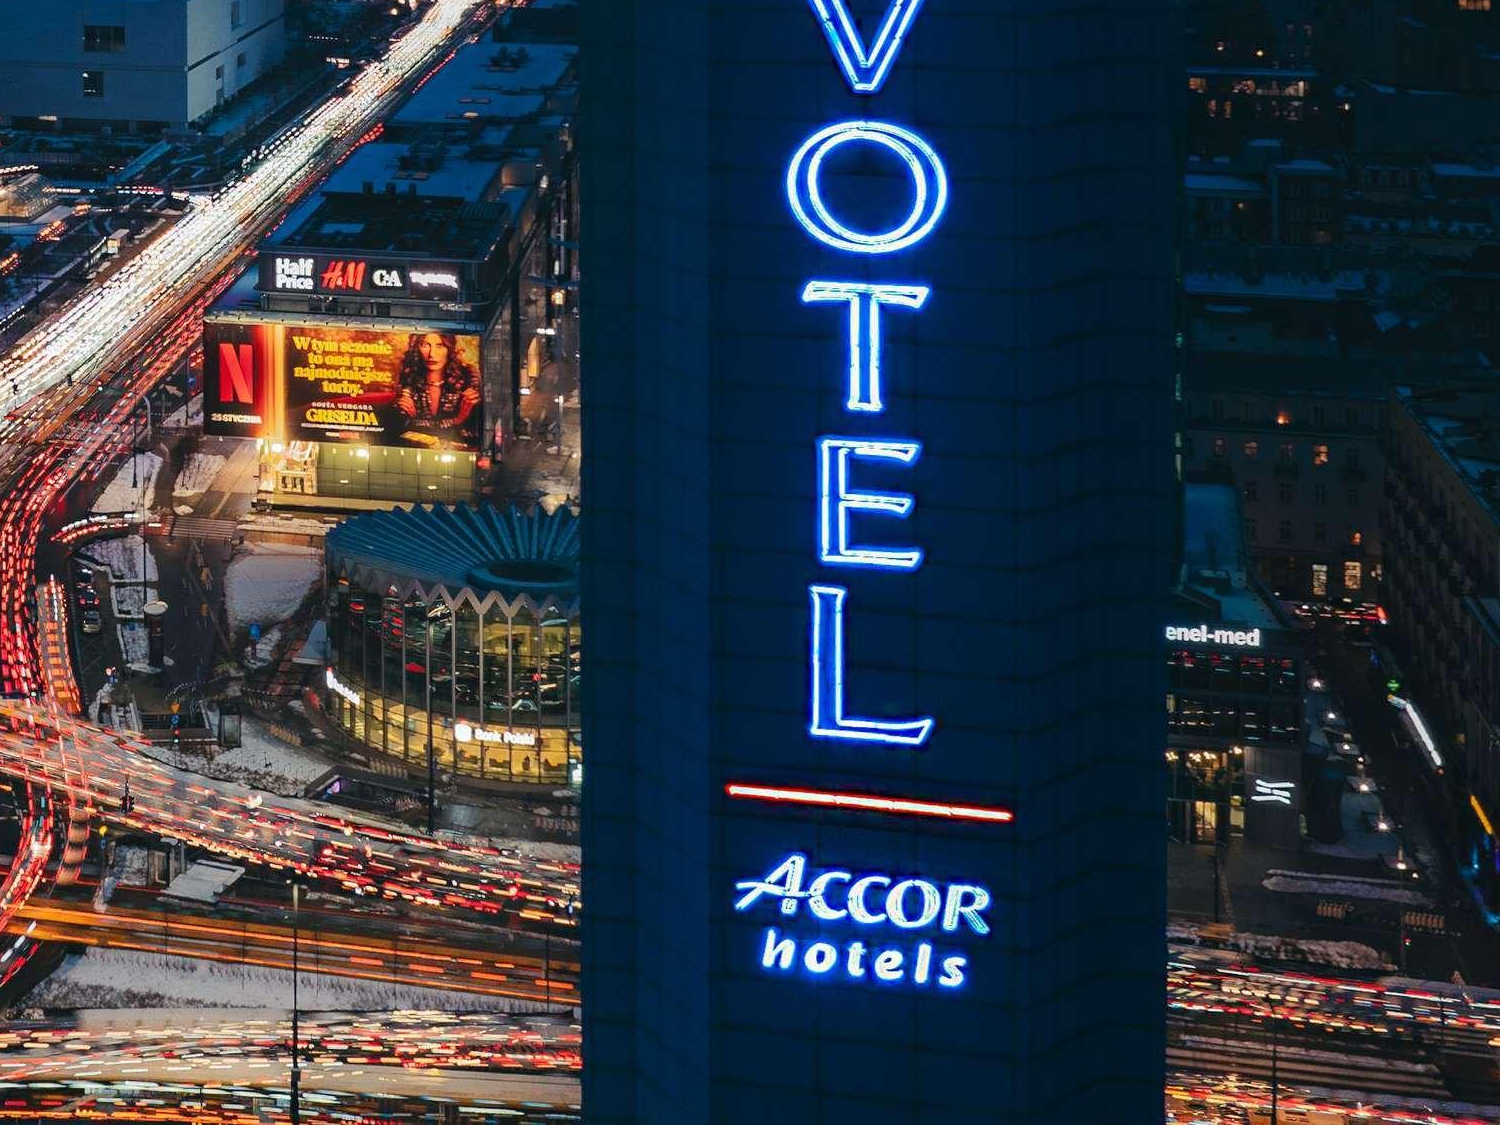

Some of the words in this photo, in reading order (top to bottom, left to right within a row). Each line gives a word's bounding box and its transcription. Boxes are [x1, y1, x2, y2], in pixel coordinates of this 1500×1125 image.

[275, 257, 314, 276] Half
[321, 260, 366, 291] H&M
[275, 274, 313, 290] Price
[293, 336, 310, 350] W
[308, 352, 323, 365] to
[306, 408, 379, 426] GRISELDA
[1166, 624, 1260, 646] enel-med
[475, 728, 502, 742] Bank
[503, 731, 536, 746] Polski
[734, 852, 991, 935] ACCOR
[761, 928, 968, 988] hotels
